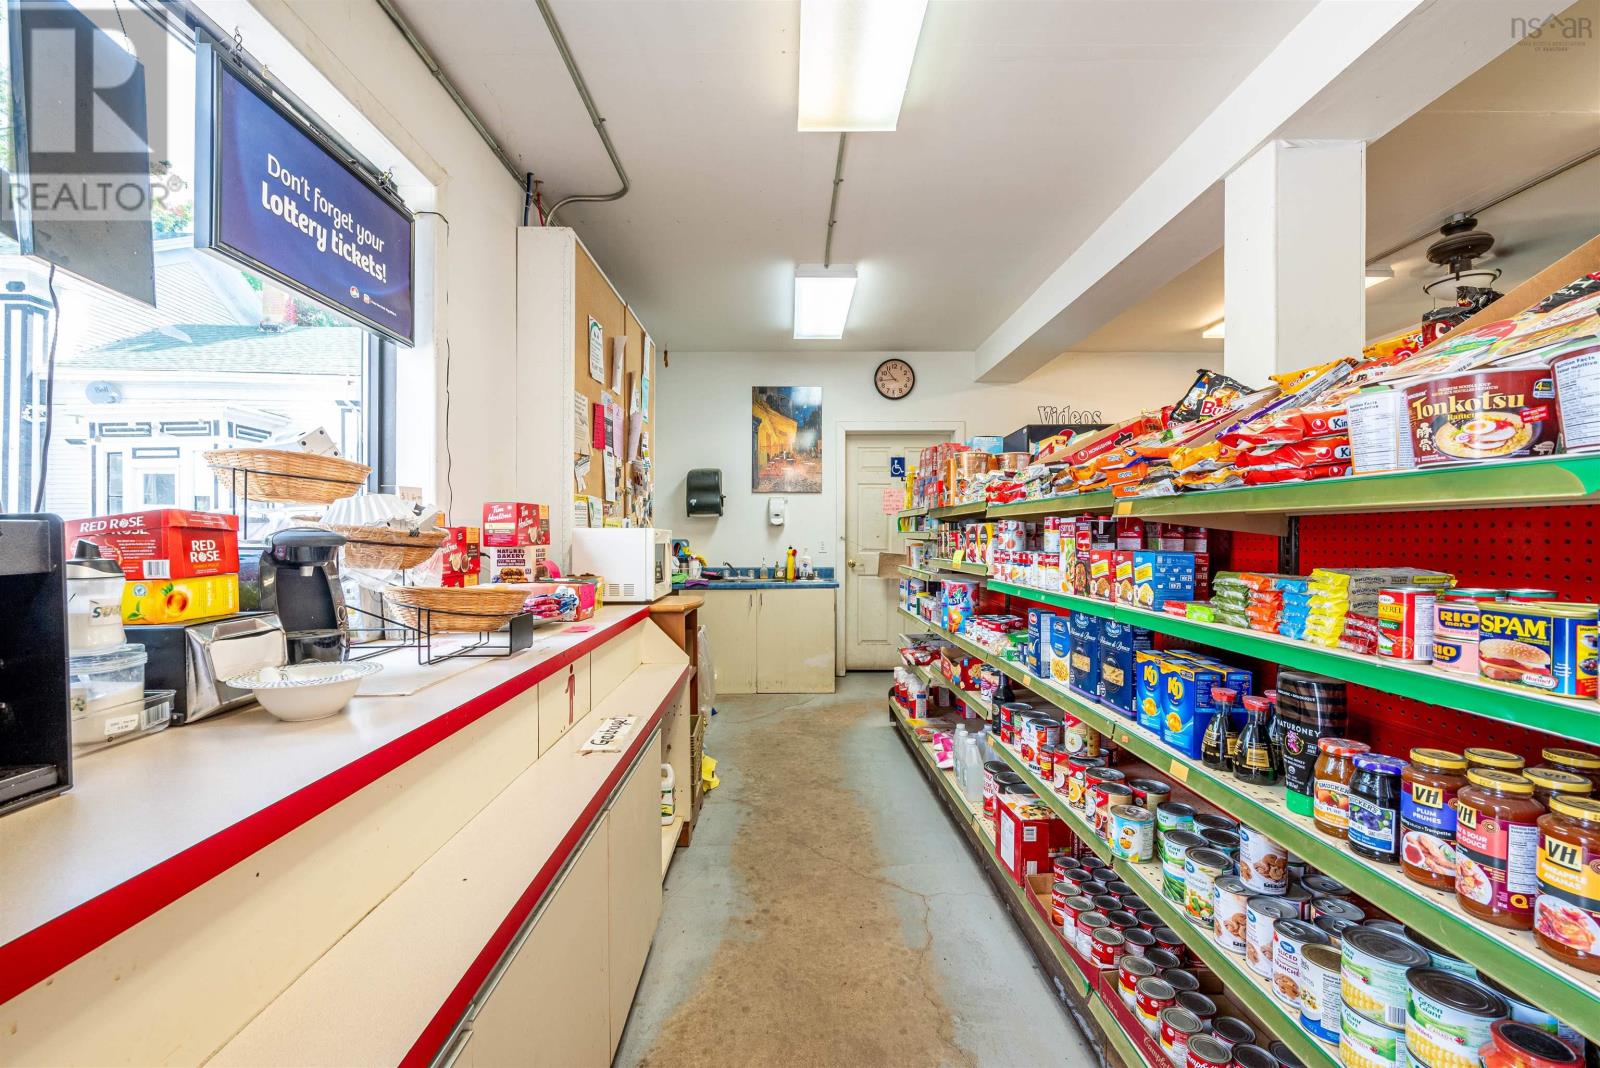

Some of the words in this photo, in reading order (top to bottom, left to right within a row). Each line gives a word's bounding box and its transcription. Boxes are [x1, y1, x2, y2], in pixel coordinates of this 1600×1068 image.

[267, 152, 311, 201] Don't
[313, 187, 354, 232] forget
[356, 223, 386, 253] your
[261, 181, 328, 253] lottery
[331, 229, 388, 284] tickets!
[1038, 405, 1102, 424] Videos
[1412, 392, 1526, 422] Tonkotsu
[492, 505, 504, 513] Tim
[80, 520, 107, 532] RED
[109, 516, 145, 530] ROSE
[191, 540, 216, 551] RED
[190, 551, 220, 563] ROSE
[1440, 611, 1479, 623] RIO
[1480, 614, 1547, 640] SPAM
[1144, 665, 1158, 686] KD
[1168, 677, 1183, 699] KD
[1415, 786, 1439, 804] VH
[1413, 812, 1442, 824] PRUNES
[1417, 808, 1436, 817] PLUM
[1468, 832, 1488, 843] SOUR
[1548, 840, 1577, 865] VH
[1278, 948, 1298, 962] SLICED
[1418, 997, 1443, 1014] Green
[1420, 1004, 1441, 1019] Giant
